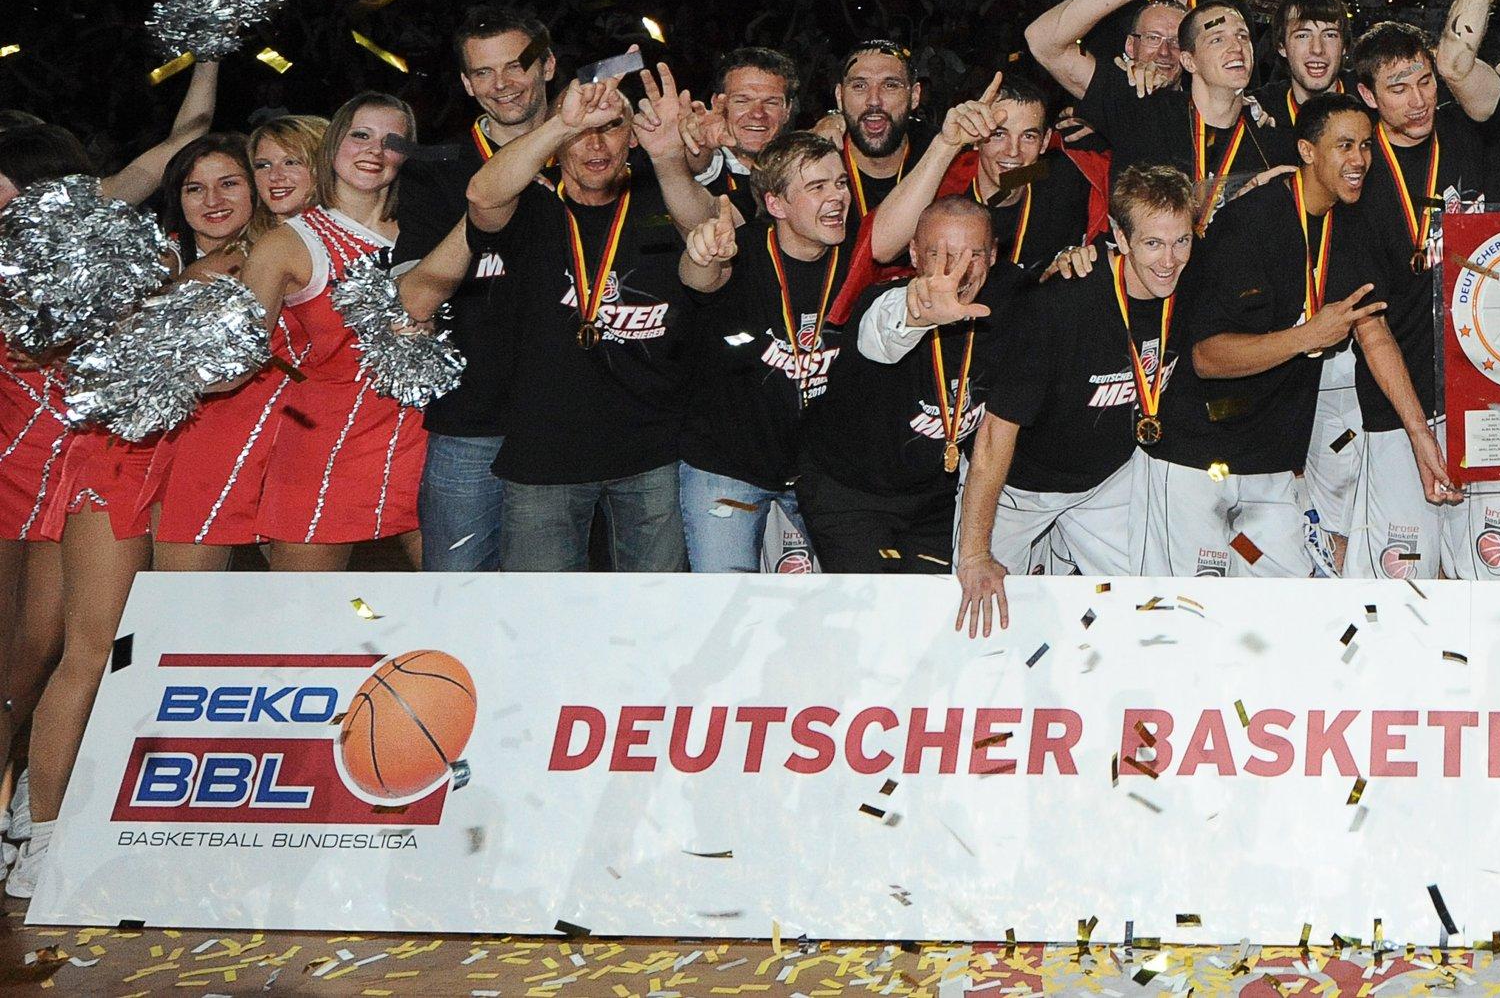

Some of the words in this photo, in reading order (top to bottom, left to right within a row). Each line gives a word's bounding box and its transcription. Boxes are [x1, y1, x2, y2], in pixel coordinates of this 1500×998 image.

[783, 531, 803, 539] bro
[1388, 522, 1420, 533] brose
[1199, 548, 1228, 559] brose
[156, 686, 339, 723] BEKO
[547, 705, 1083, 776] DEUTSCHER
[132, 755, 314, 806] BBL
[117, 831, 264, 848] BASKETBALL
[271, 833, 418, 850] BUNDESLIGA
